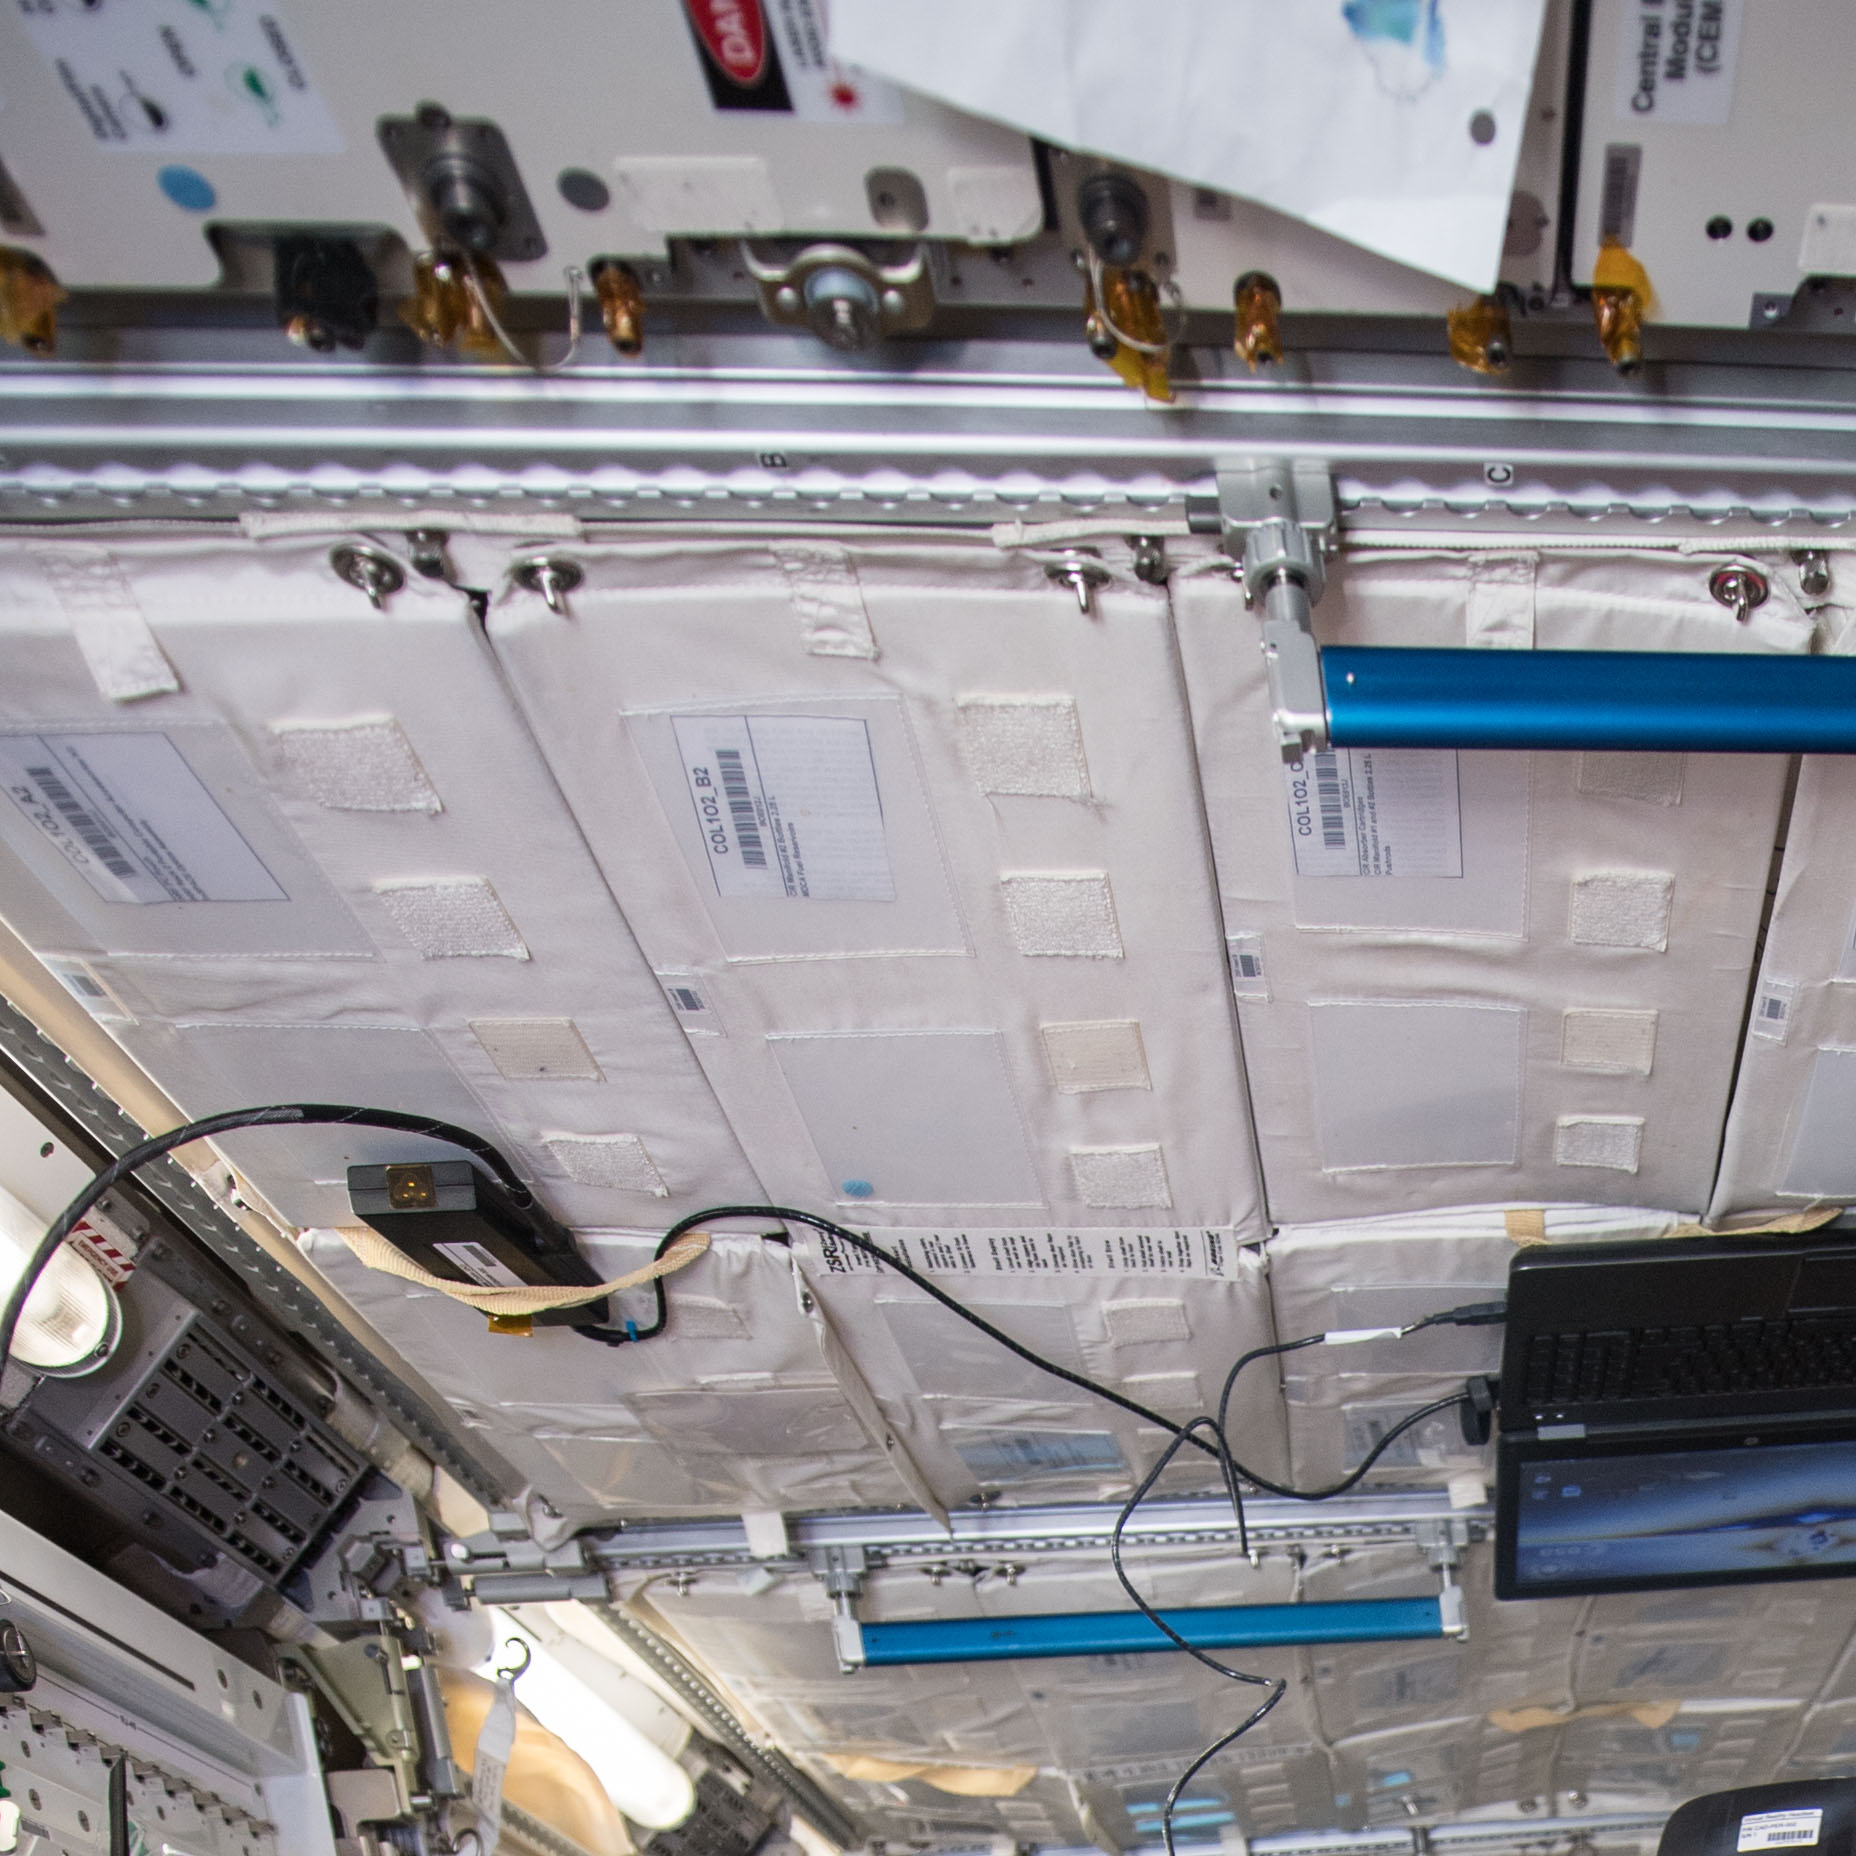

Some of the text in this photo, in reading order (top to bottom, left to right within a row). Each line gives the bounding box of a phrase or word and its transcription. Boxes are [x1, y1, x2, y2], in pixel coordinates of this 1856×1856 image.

[1629, 15, 1665, 114] Central
[1487, 466, 1511, 482] C
[1289, 760, 1317, 836] COL1O2_C
